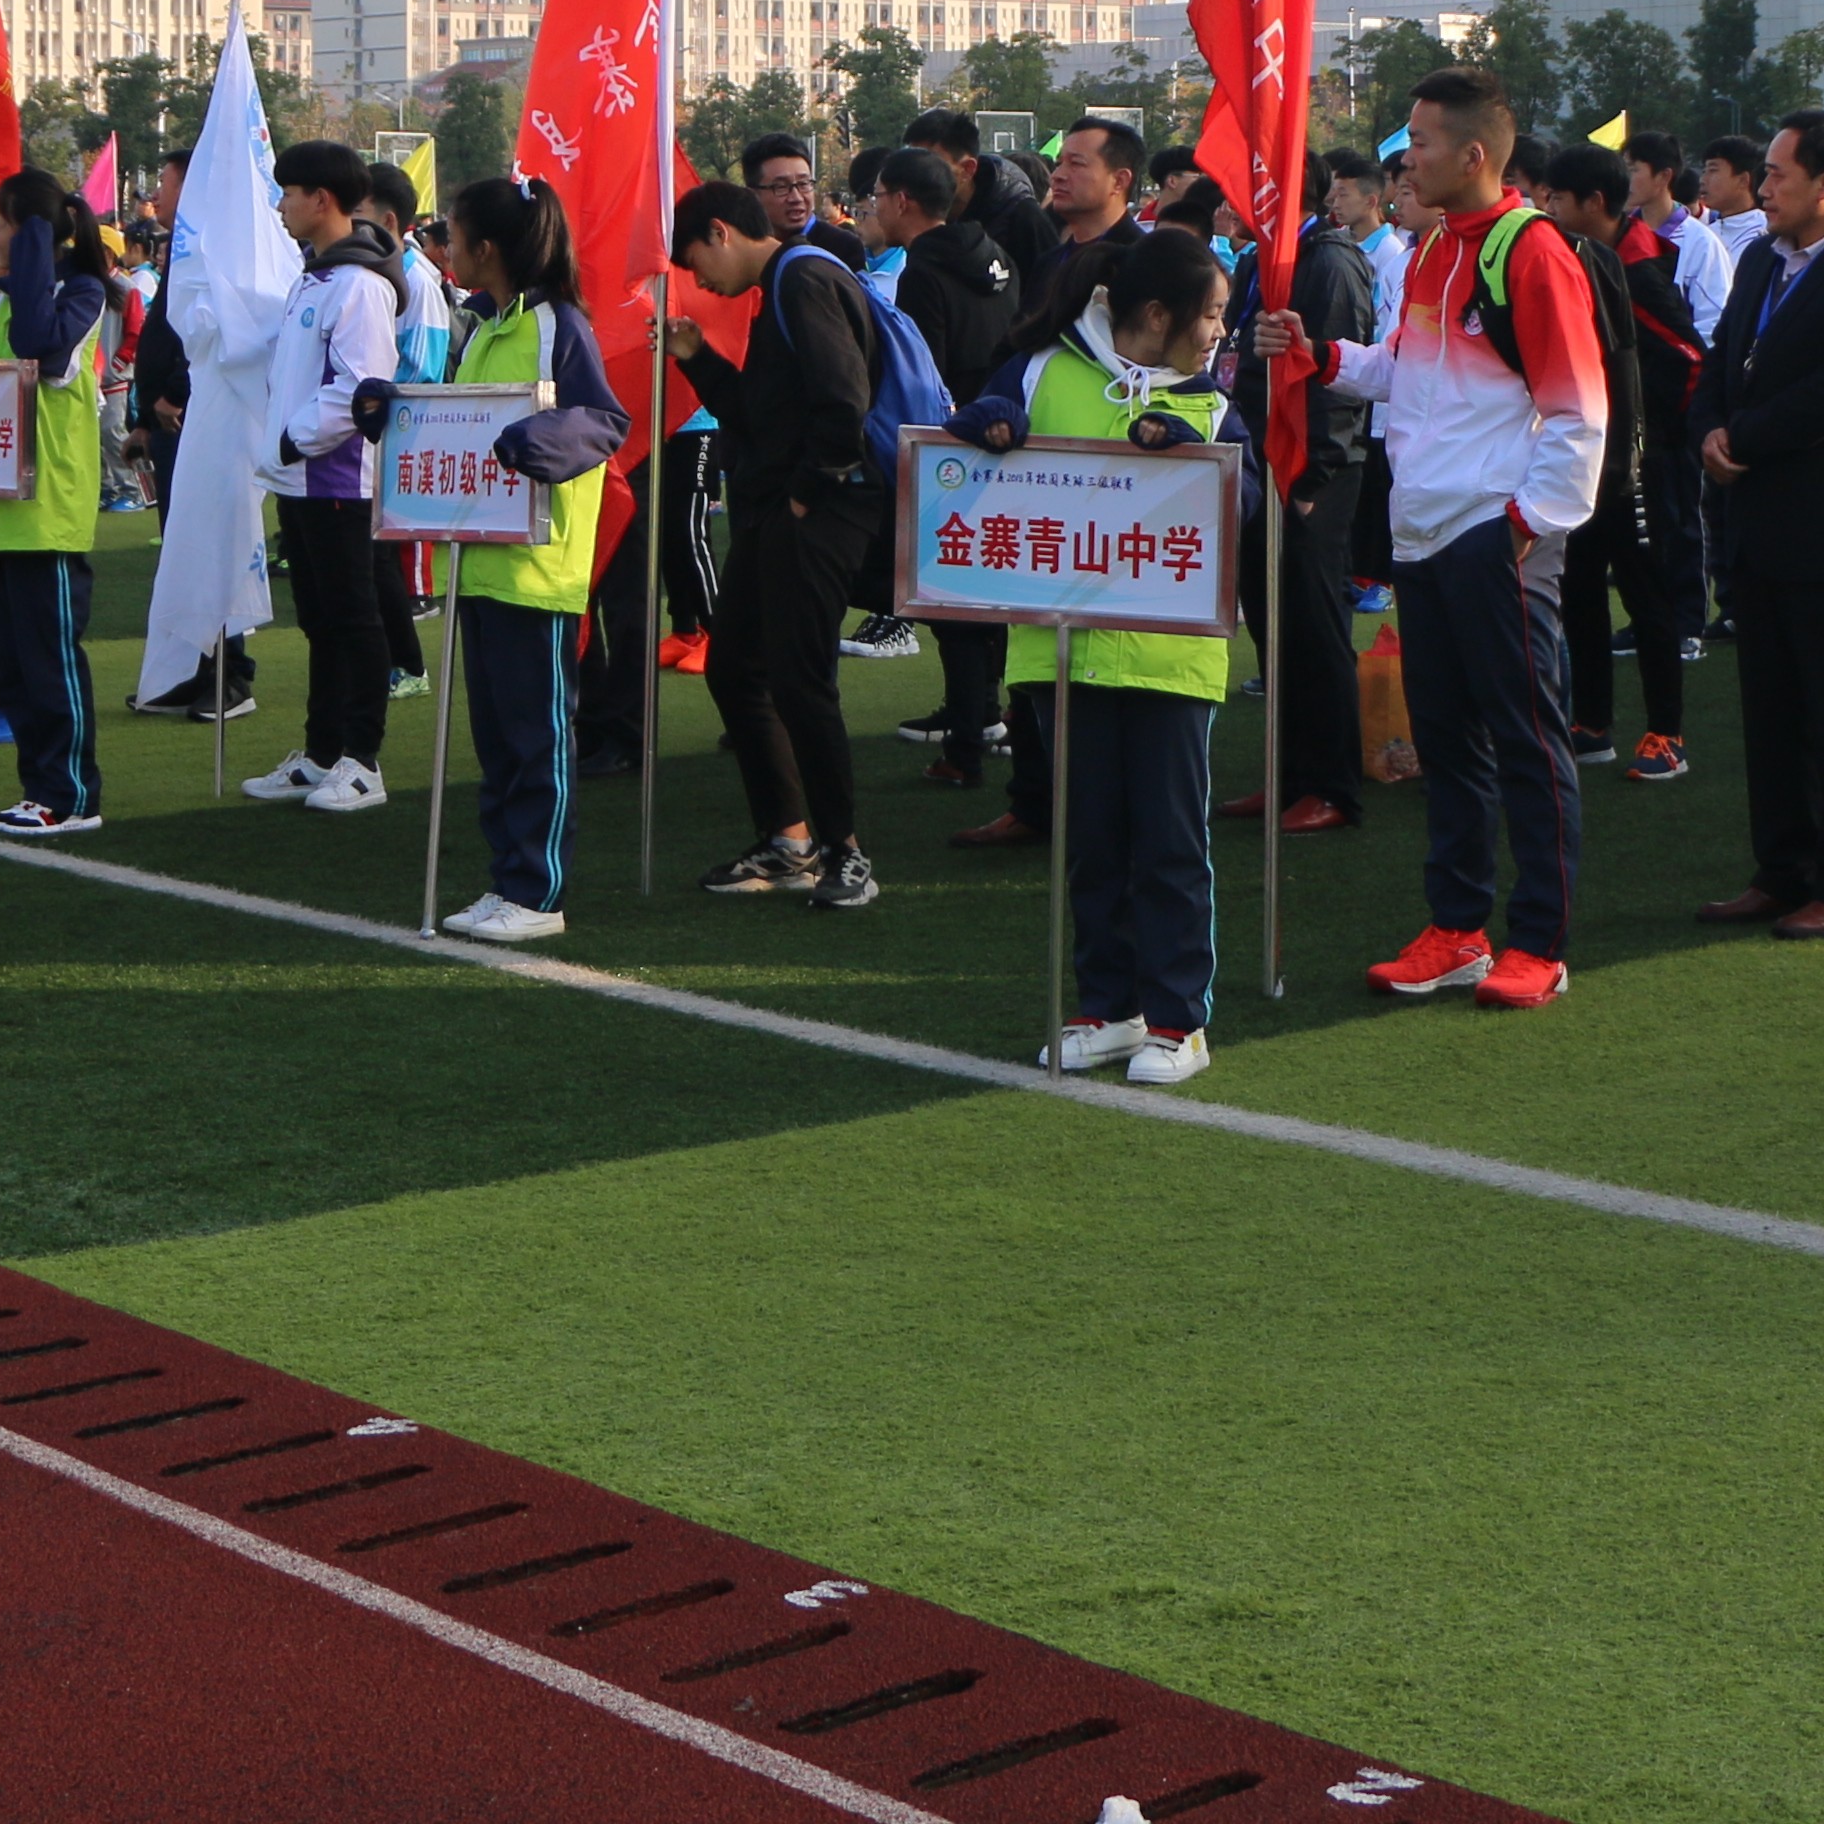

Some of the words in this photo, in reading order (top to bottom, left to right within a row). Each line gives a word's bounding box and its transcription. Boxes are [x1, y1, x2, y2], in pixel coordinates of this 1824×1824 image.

[935, 511, 1203, 582] 金寨青山中学
[346, 1416, 419, 1436] 4
[783, 1580, 870, 1608] 3
[1326, 1766, 1425, 1805] 2
